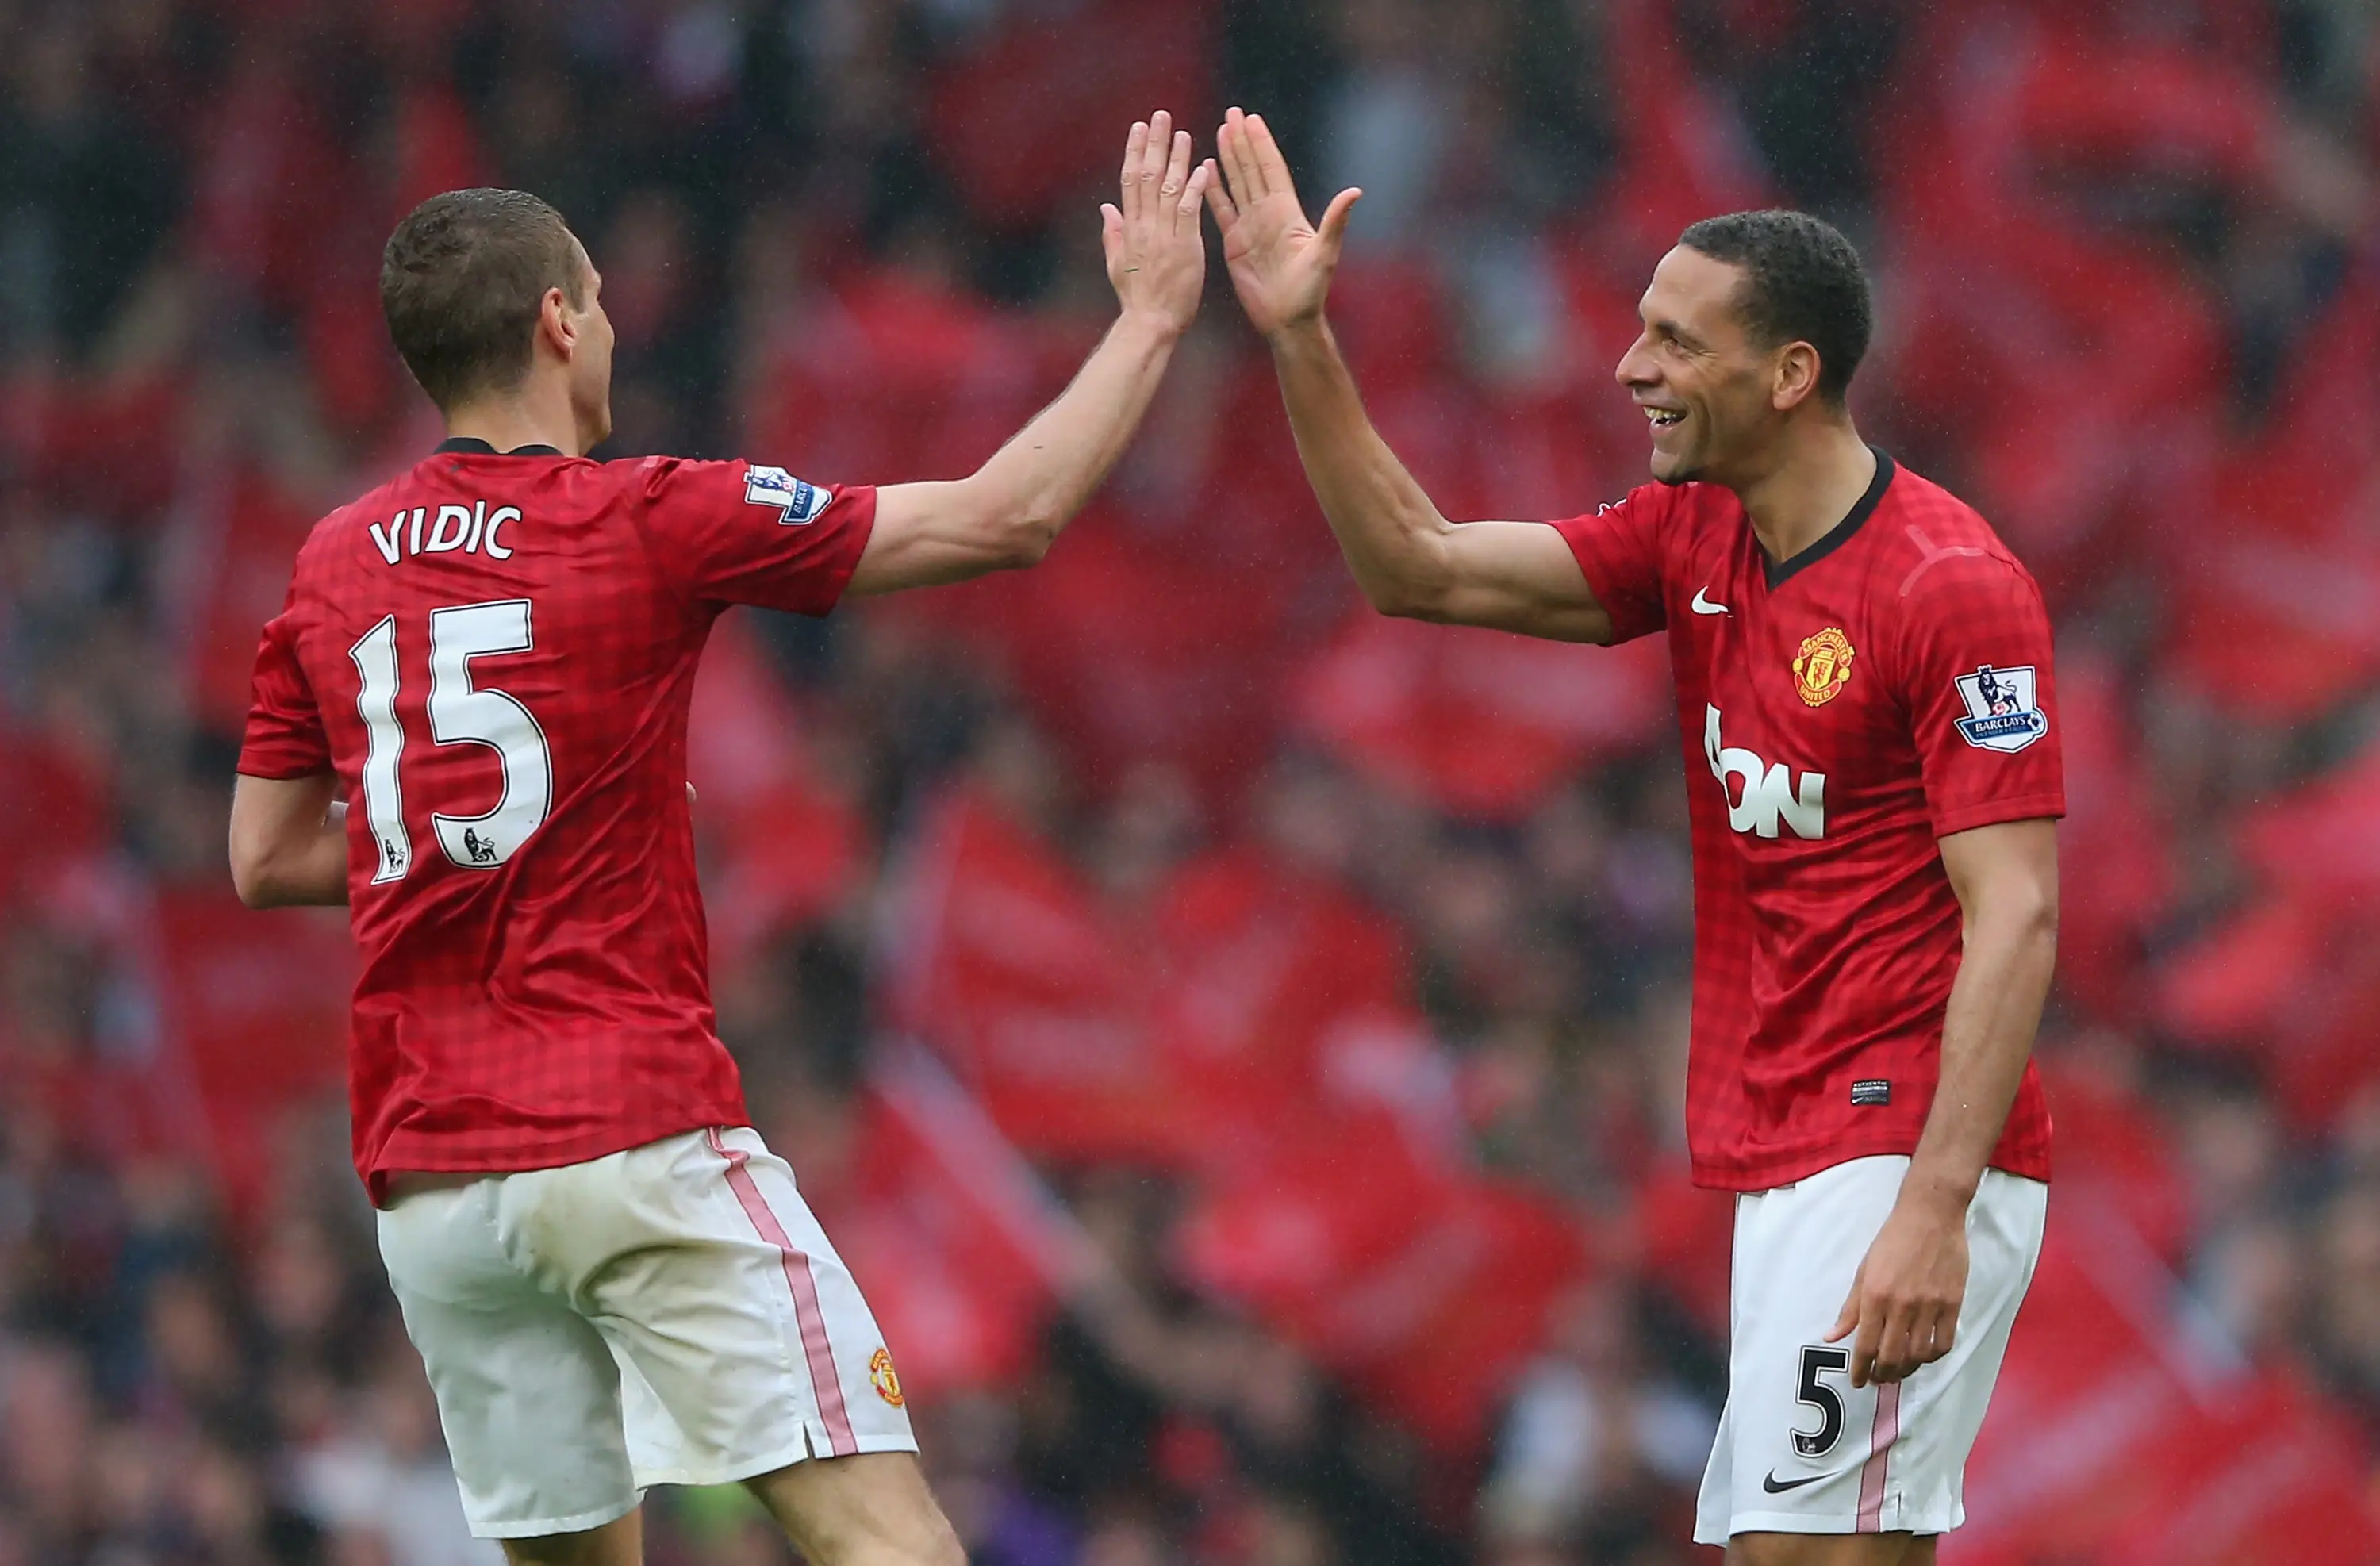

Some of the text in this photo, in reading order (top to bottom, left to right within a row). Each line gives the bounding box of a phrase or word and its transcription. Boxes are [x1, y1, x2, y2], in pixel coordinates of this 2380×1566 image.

[368, 500, 523, 566] VIDIC
[1802, 634, 1848, 662] MANCHESTER
[1799, 685, 1831, 700] UNITED
[347, 598, 553, 885] 15
[1975, 716, 2026, 732] BARCLAYS
[1790, 1345, 1851, 1458] 5
